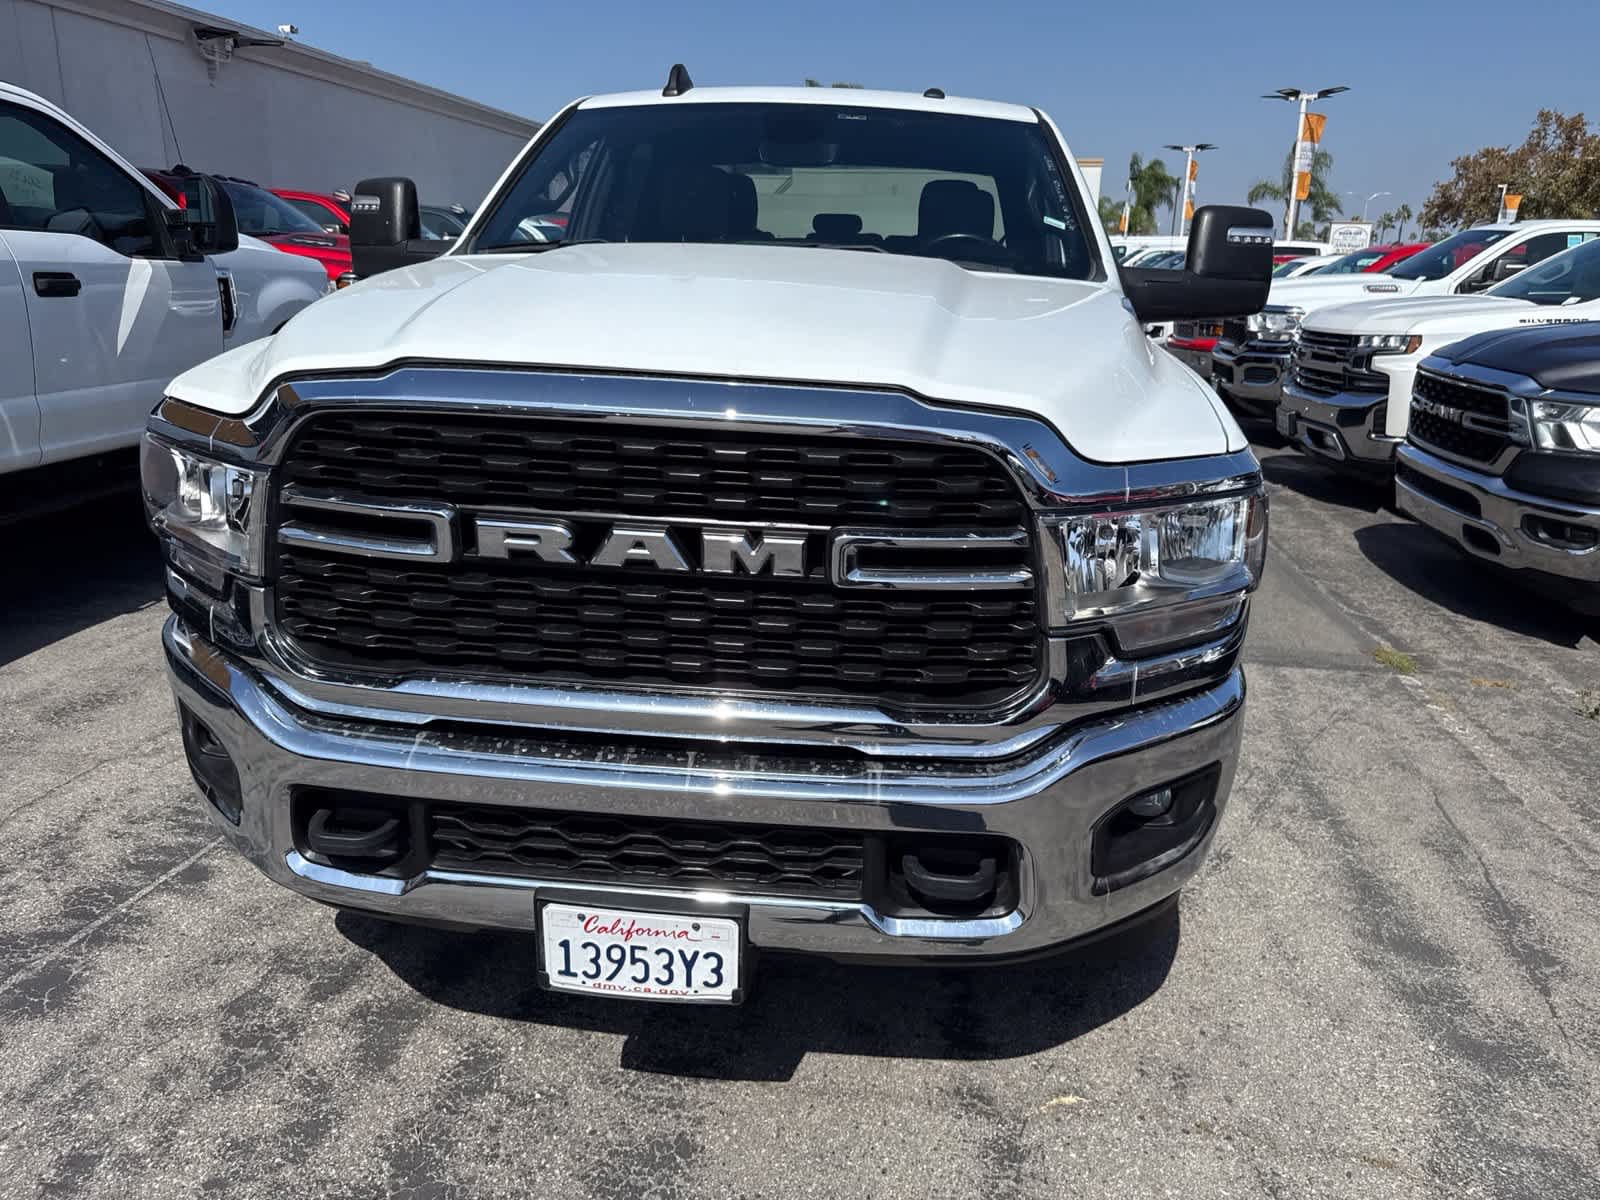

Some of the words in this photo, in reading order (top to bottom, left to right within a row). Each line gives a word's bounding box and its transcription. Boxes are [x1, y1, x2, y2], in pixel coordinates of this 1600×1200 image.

[1422, 400, 1461, 423] RAM
[475, 516, 808, 576] RAM
[583, 915, 702, 941] California
[557, 939, 724, 988] 13953Y3
[592, 981, 690, 996] dmv.ca.gov
